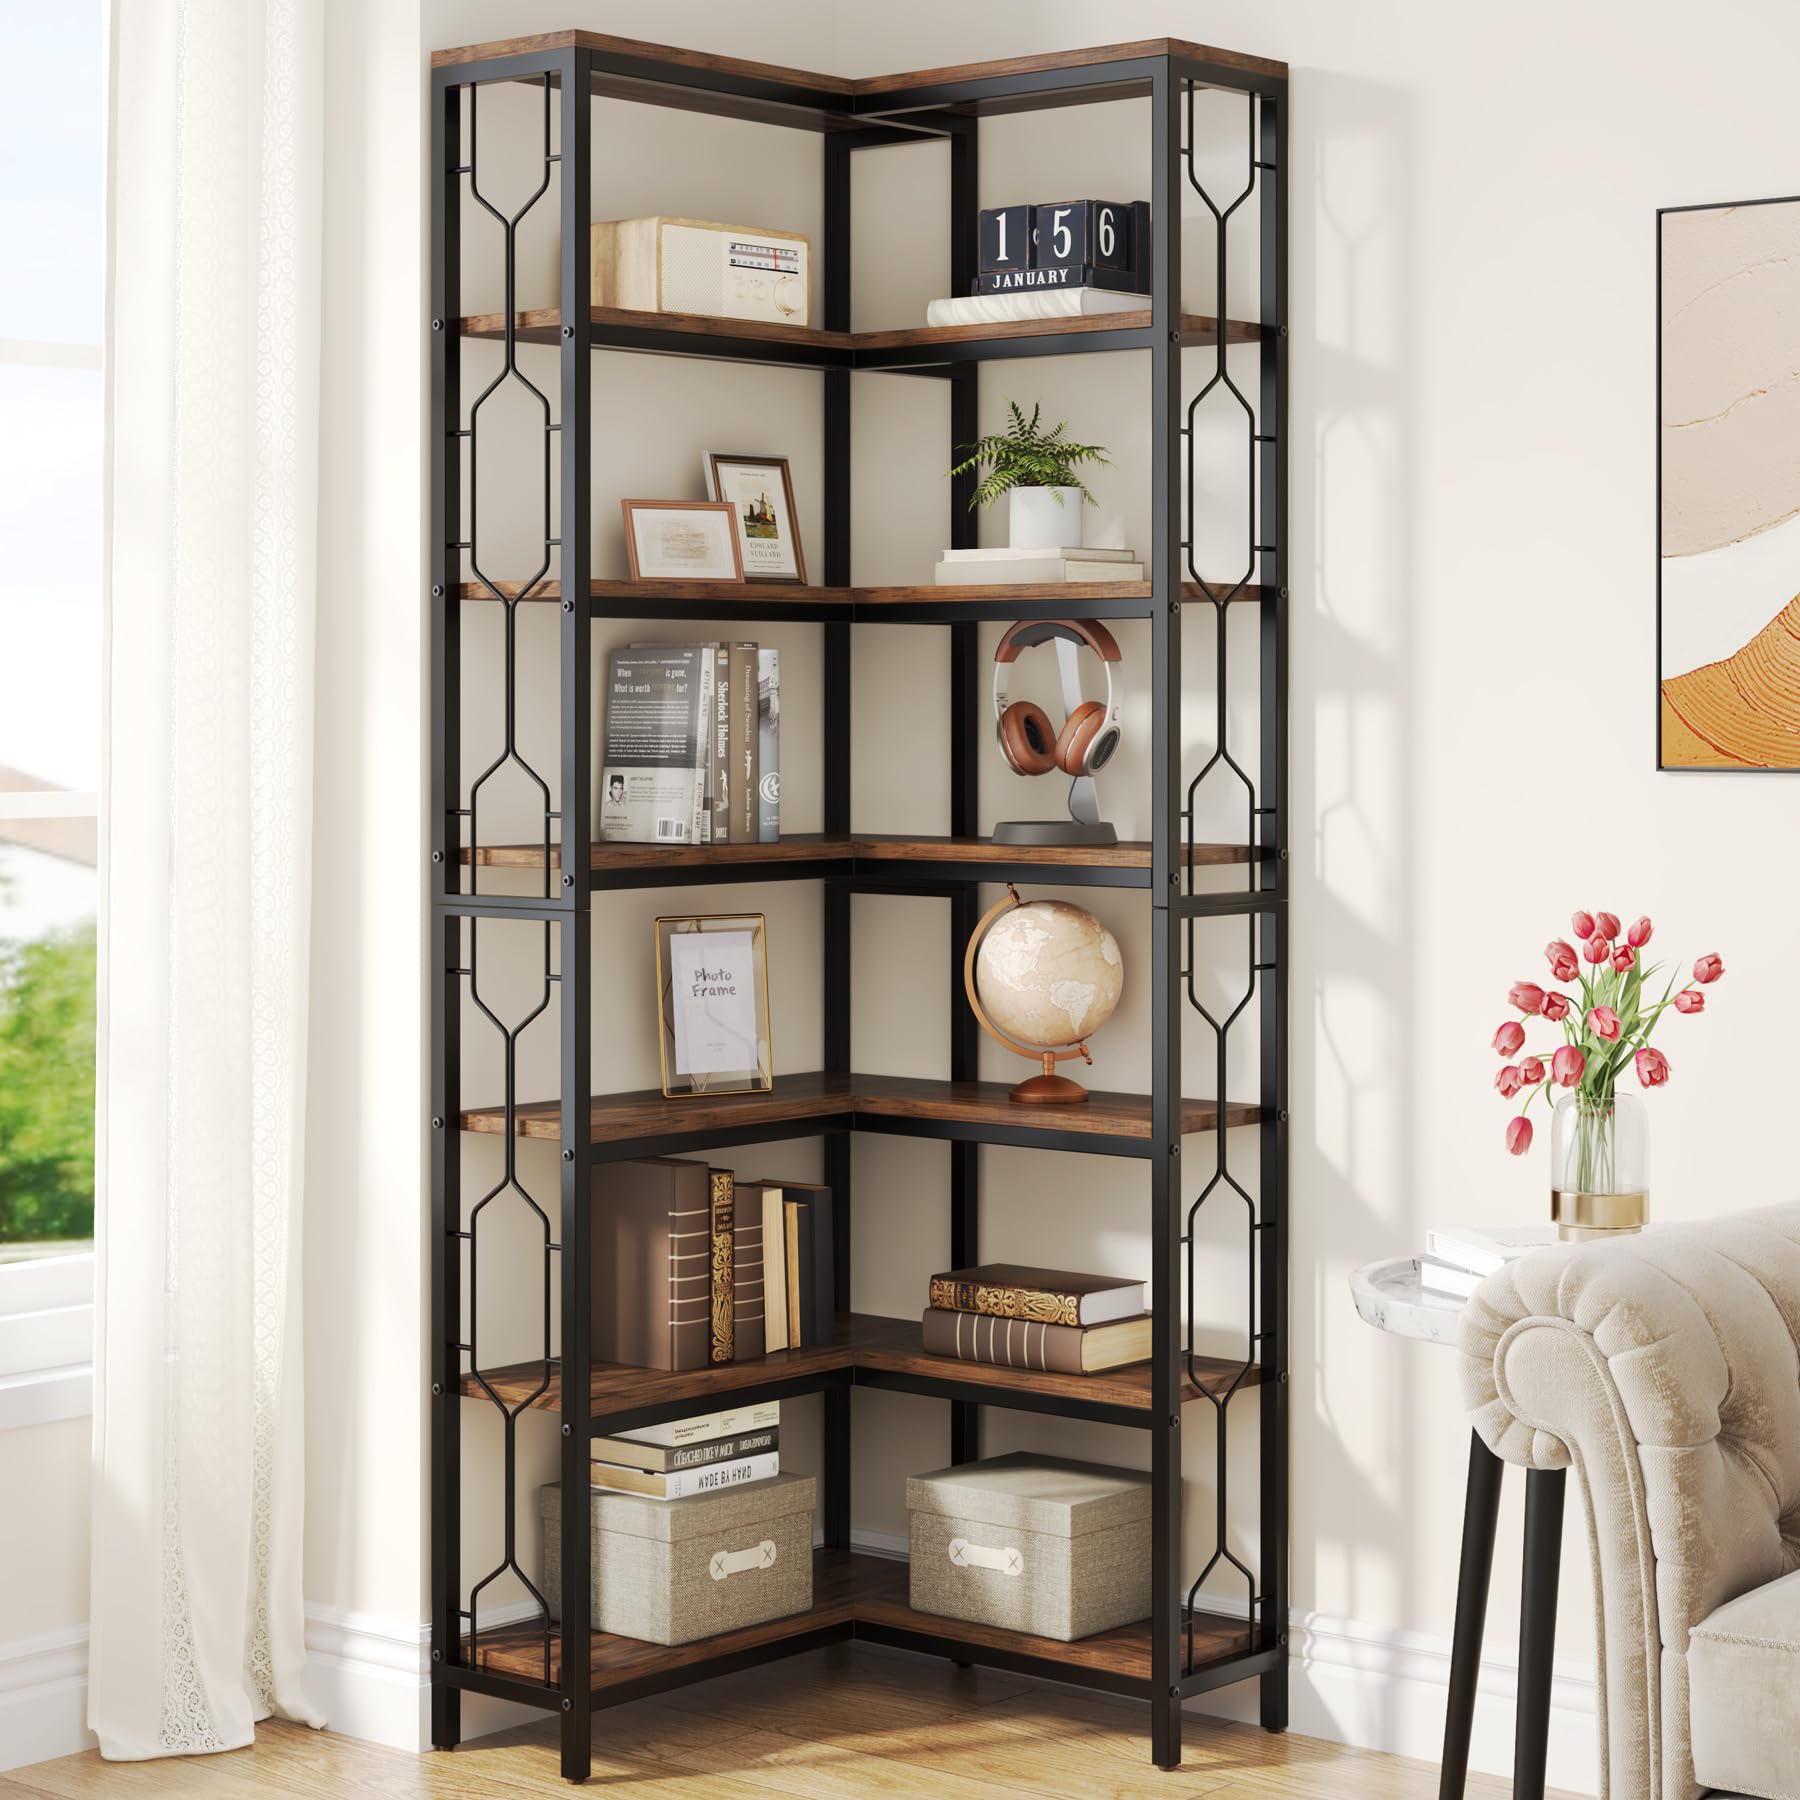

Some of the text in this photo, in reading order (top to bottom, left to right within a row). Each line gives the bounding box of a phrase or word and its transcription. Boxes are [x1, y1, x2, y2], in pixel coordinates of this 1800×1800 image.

[995, 208, 1072, 261] 1 5
[1099, 207, 1115, 257] 6
[992, 268, 1069, 289] JANUARY
[617, 668, 632, 678] When
[744, 665, 752, 702] Dreaming
[614, 683, 628, 693] What
[629, 683, 634, 693] is
[635, 683, 651, 693] worth
[717, 681, 729, 758] Sherlock Holmes
[694, 967, 732, 982] Photo
[692, 983, 737, 997] Frame
